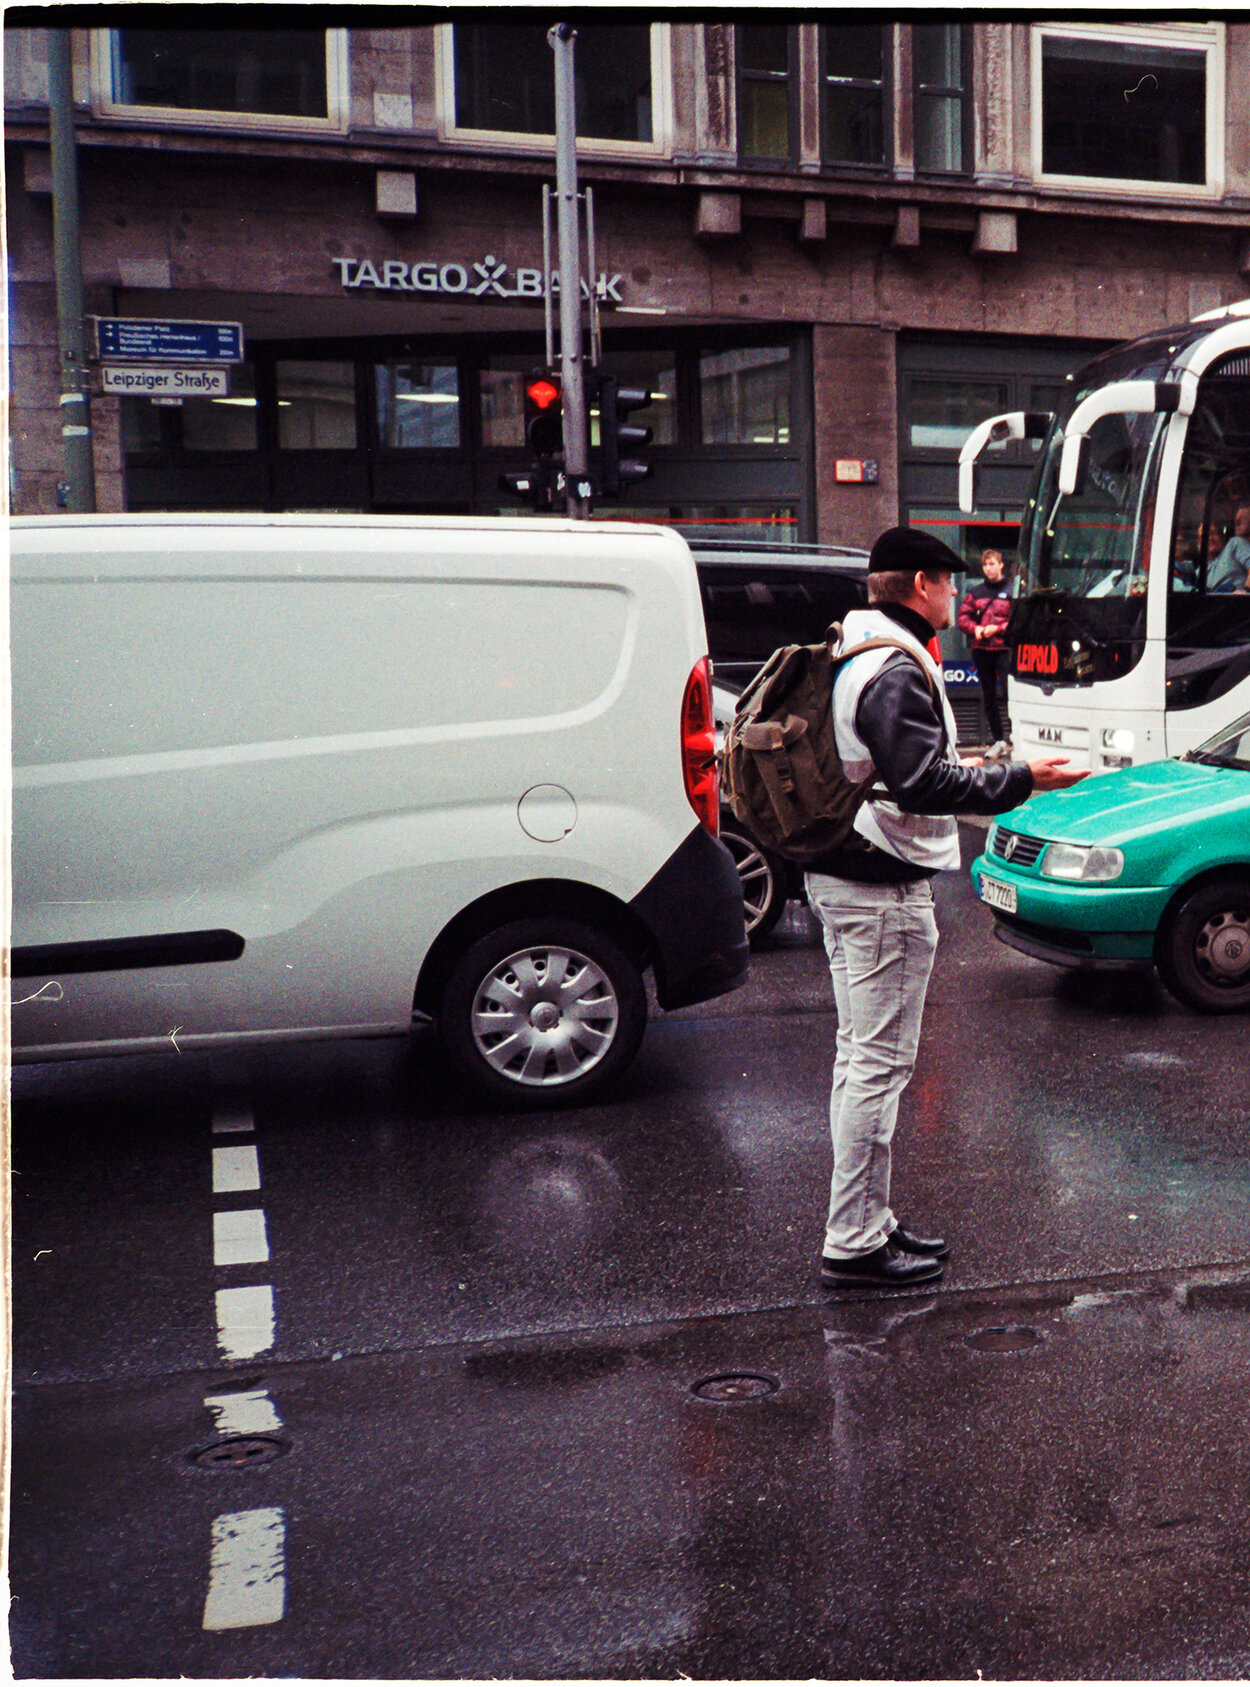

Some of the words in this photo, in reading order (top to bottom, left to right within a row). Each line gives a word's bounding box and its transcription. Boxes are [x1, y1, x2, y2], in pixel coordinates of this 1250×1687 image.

[332, 256, 468, 293] TARGO
[104, 370, 169, 389] Leipziger
[174, 371, 220, 390] Straße
[1016, 643, 1059, 674] LEIPOLD
[1038, 728, 1062, 743] MAN
